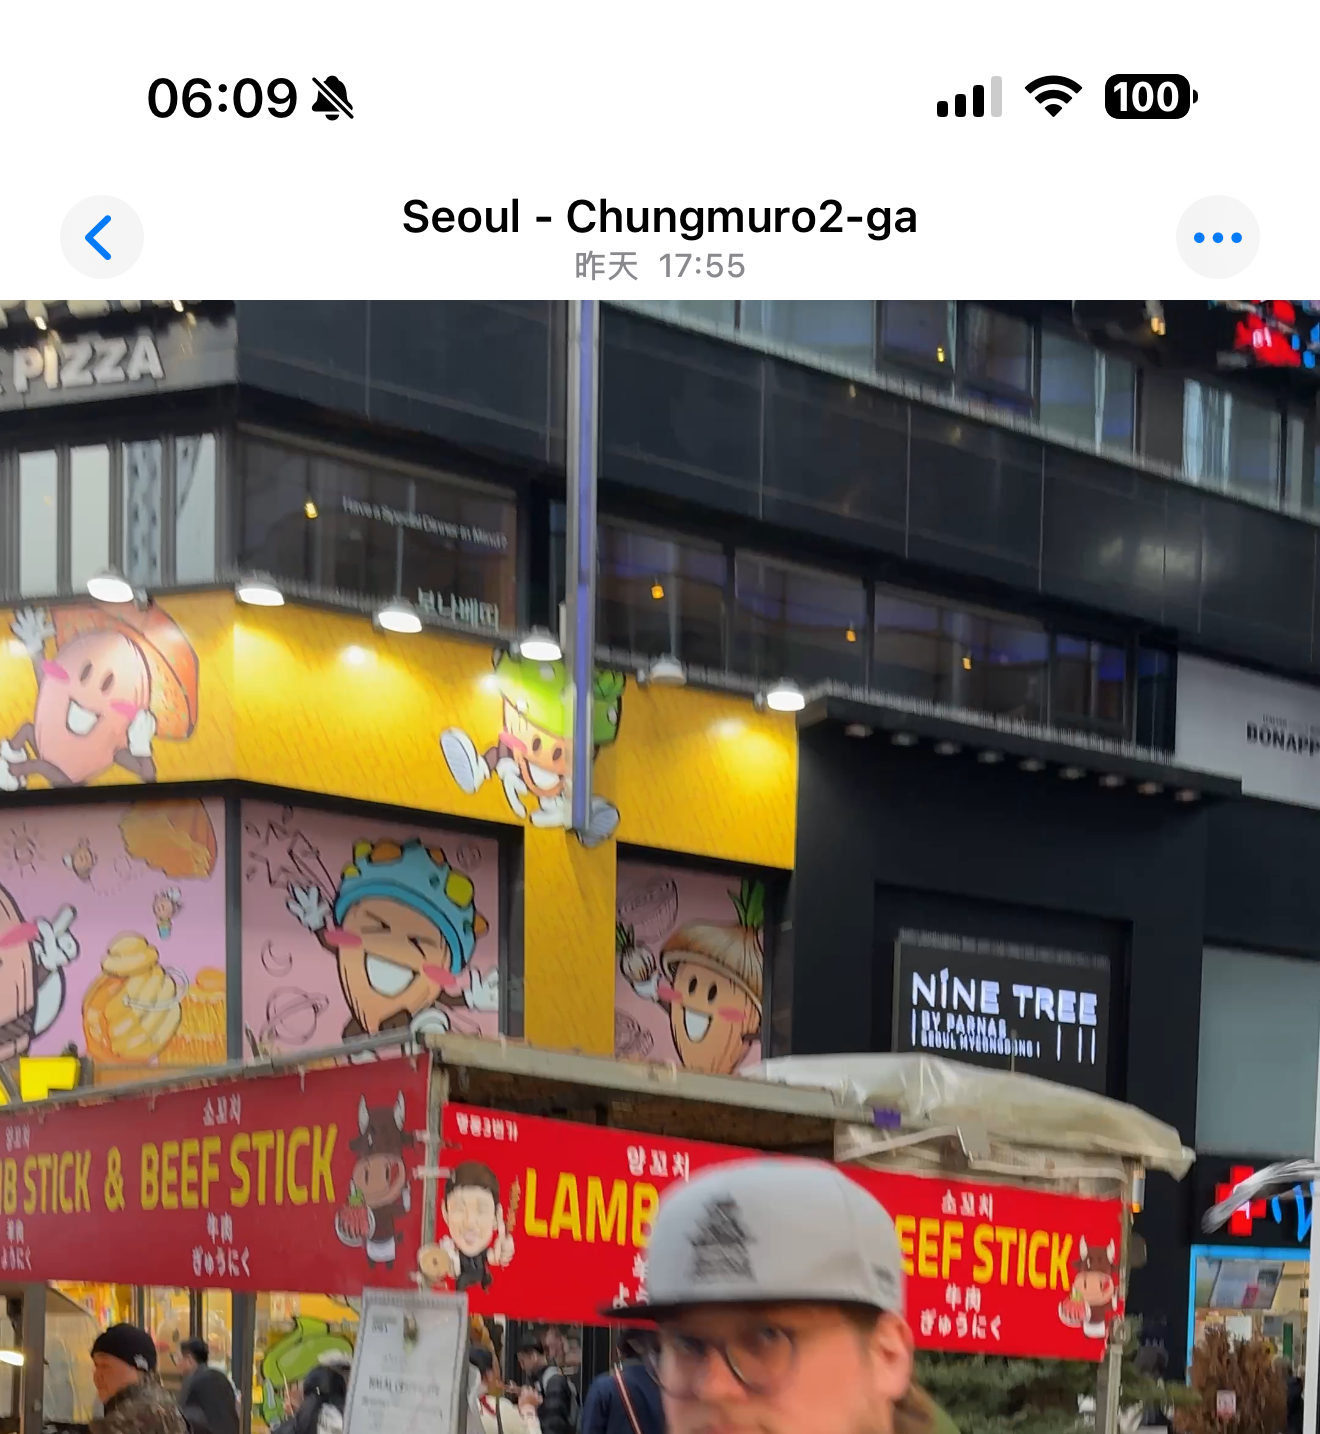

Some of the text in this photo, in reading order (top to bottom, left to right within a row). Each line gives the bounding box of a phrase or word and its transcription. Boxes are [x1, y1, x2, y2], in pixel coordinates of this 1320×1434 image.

[13, 335, 164, 392] PIZZA
[912, 967, 1098, 1027] NINE TREE
[921, 1009, 941, 1032] BY
[0, 1122, 339, 1216] B STICK & BEEF STICK
[626, 1144, 690, 1183] 양꼬치
[942, 1188, 993, 1222] 소꼬치
[524, 1167, 1073, 1292] LAMB EEF STICK
[945, 1282, 982, 1313] 牛肉
[920, 1308, 1002, 1342] ぎゅうにく
